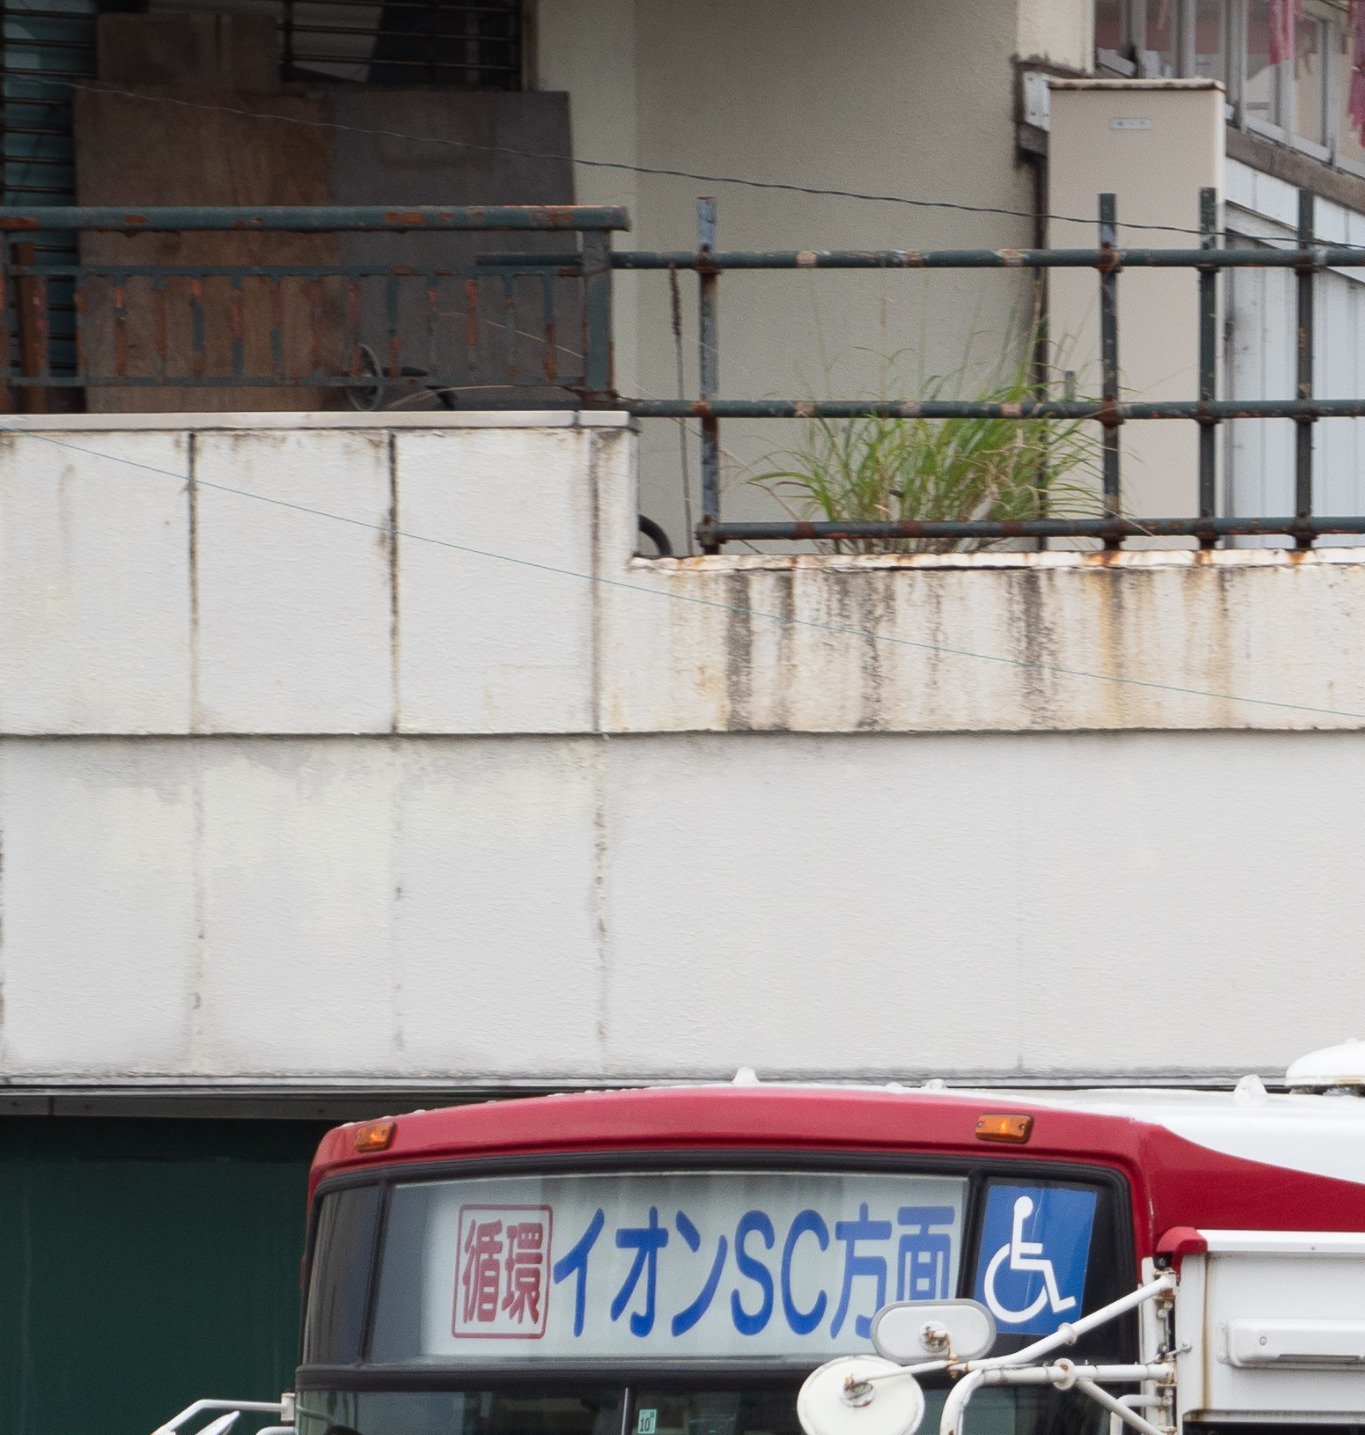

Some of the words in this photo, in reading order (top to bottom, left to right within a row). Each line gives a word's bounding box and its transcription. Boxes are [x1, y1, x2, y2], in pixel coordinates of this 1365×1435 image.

[461, 1218, 545, 1326] 循環
[552, 1201, 957, 1340] イオンSC方面
